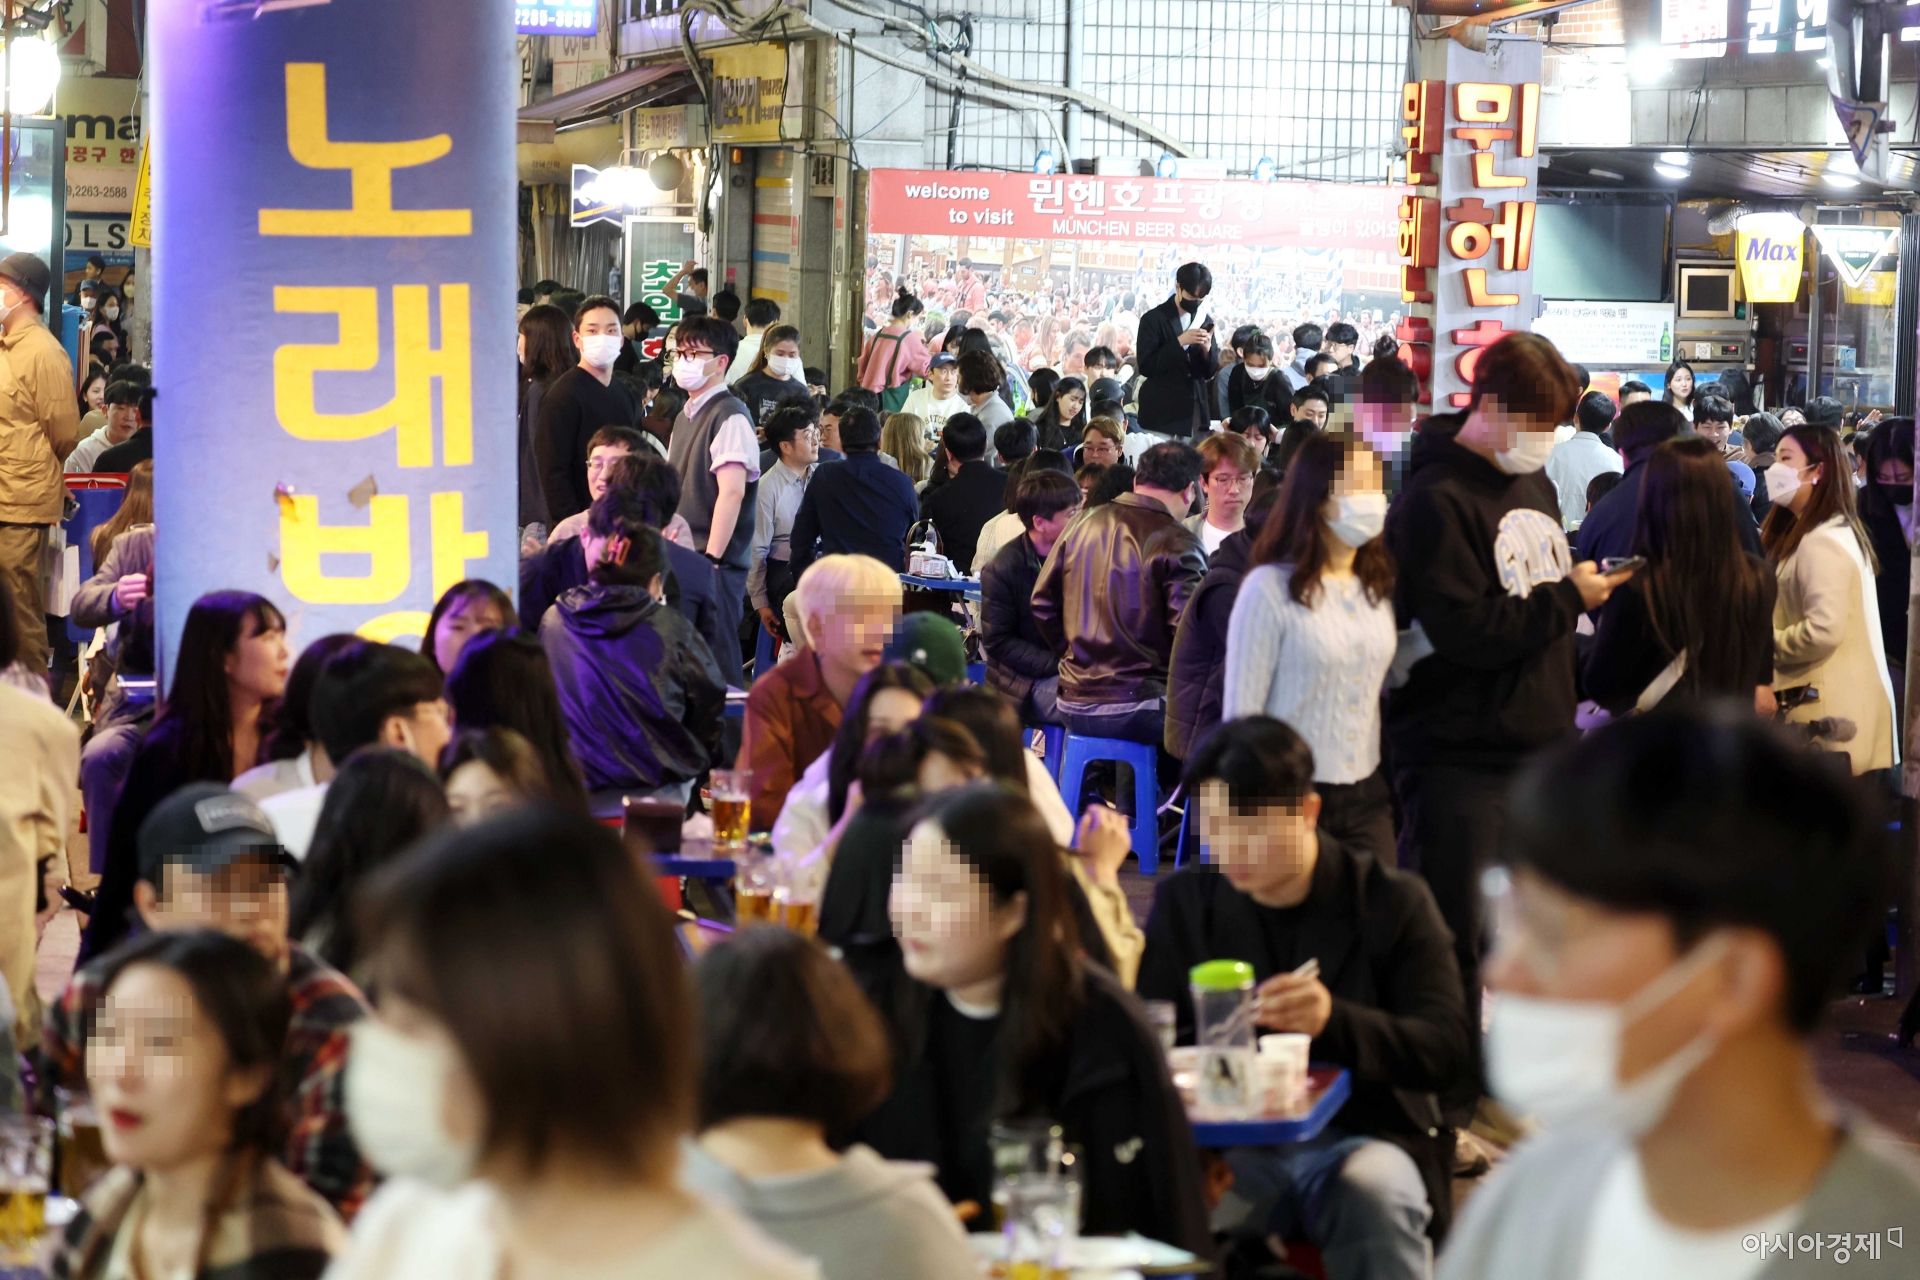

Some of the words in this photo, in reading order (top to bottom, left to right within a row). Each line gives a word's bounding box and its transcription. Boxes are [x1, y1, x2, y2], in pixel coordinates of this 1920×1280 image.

[57, 113, 140, 141] ma
[64, 147, 106, 163] 공구
[905, 182, 990, 200] welcome
[949, 208, 968, 224] to
[973, 208, 1014, 225] visit
[1053, 216, 1129, 236] MÜNCHEN
[1135, 221, 1176, 237] BEER
[1180, 223, 1243, 239] SQUARE
[1746, 238, 1798, 261] Max
